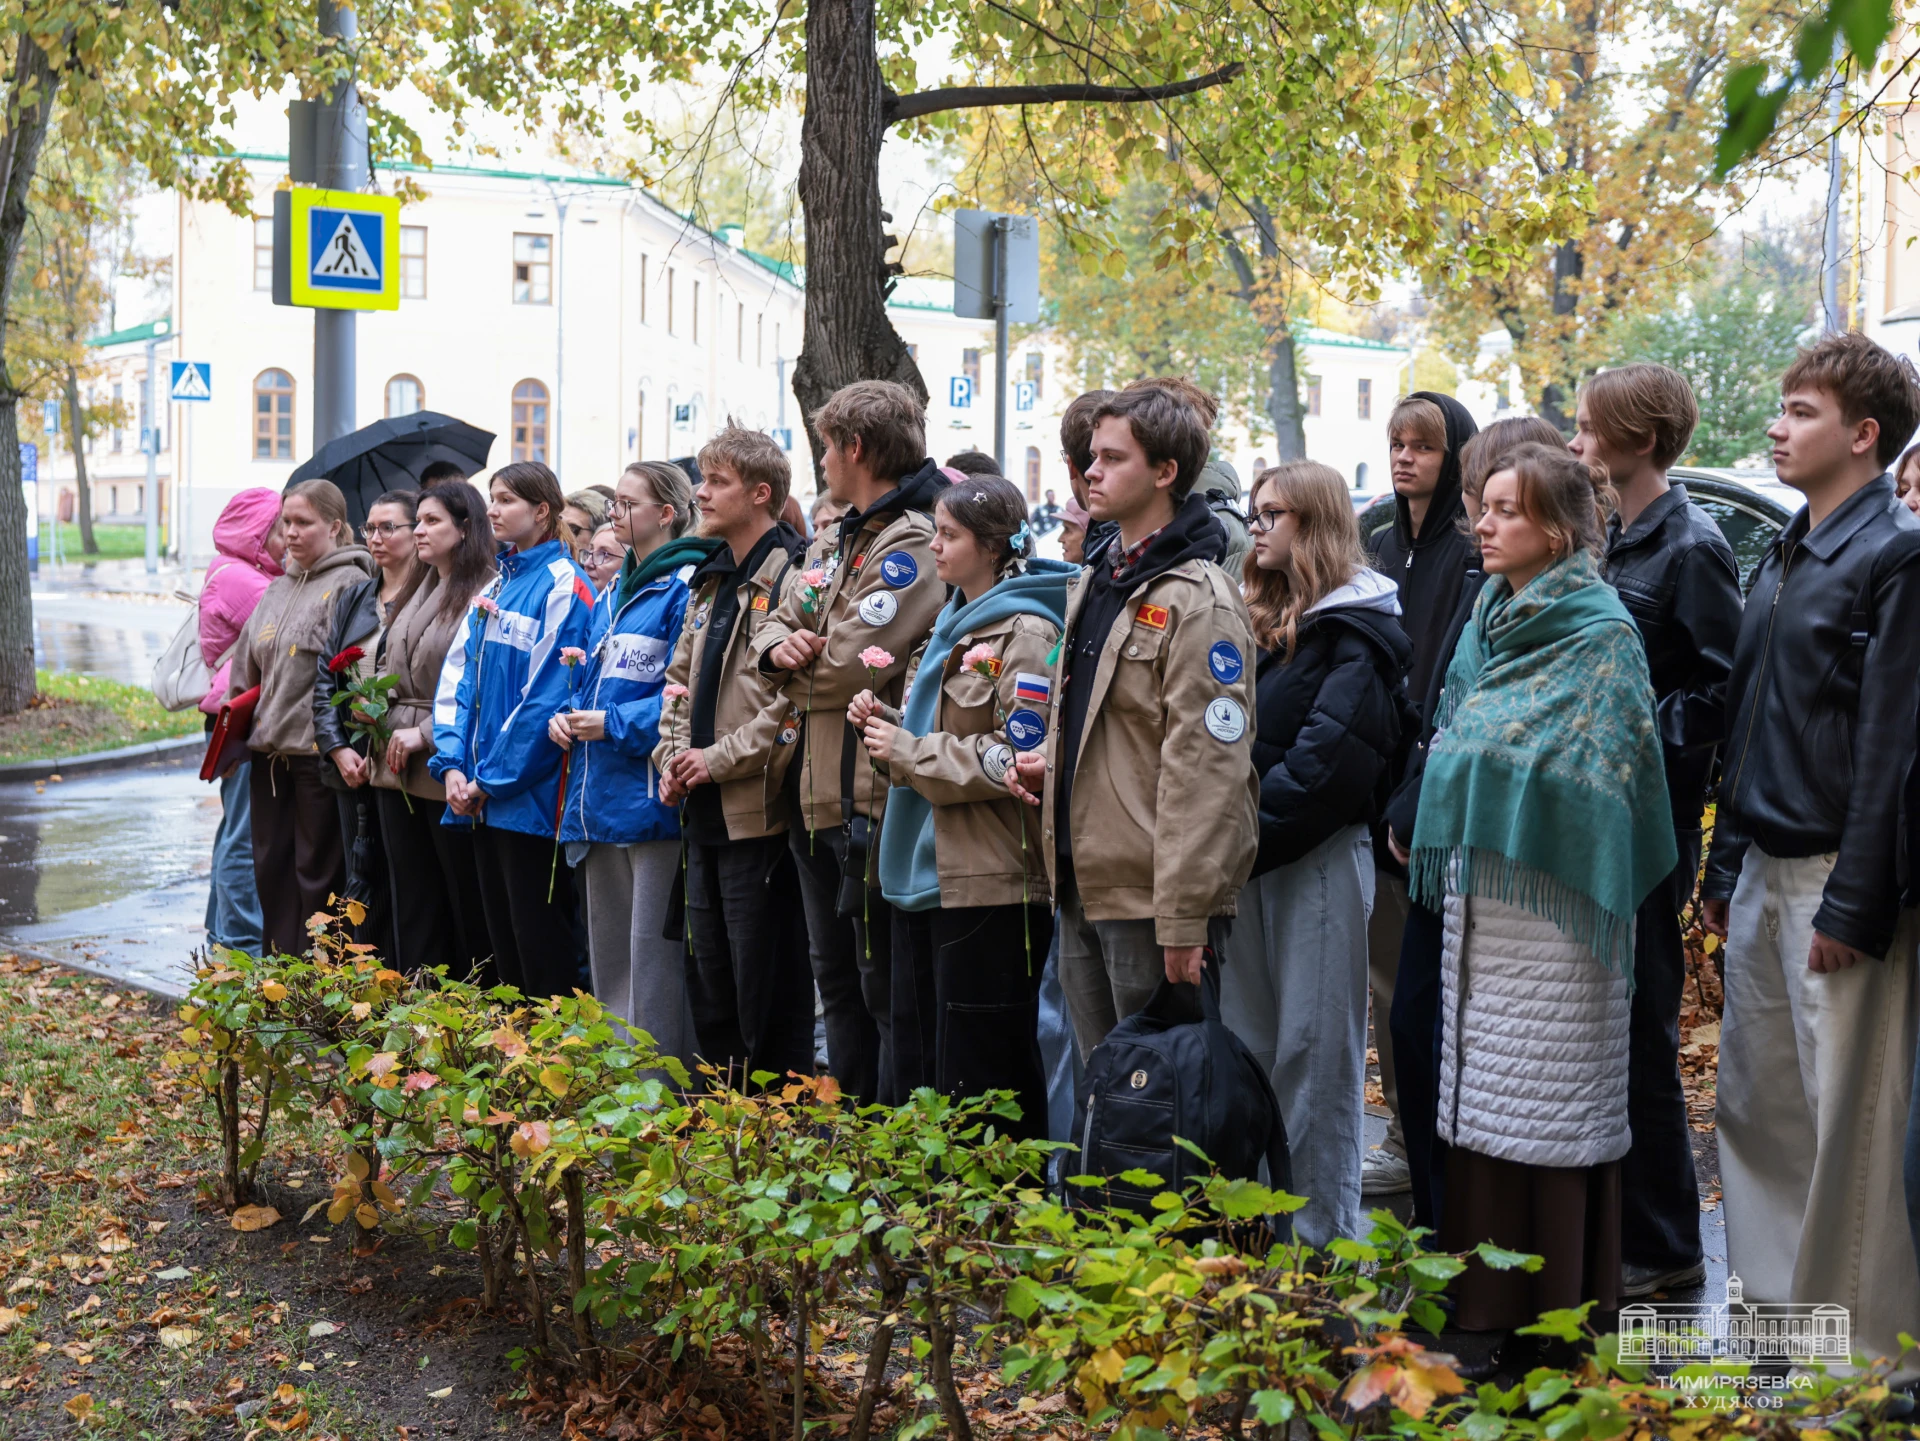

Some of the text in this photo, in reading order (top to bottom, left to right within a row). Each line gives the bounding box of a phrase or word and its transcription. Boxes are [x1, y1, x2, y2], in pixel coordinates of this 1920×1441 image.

[953, 378, 969, 406] P
[1018, 384, 1032, 410] P
[631, 649, 656, 662] Мос
[628, 659, 656, 673] РСО
